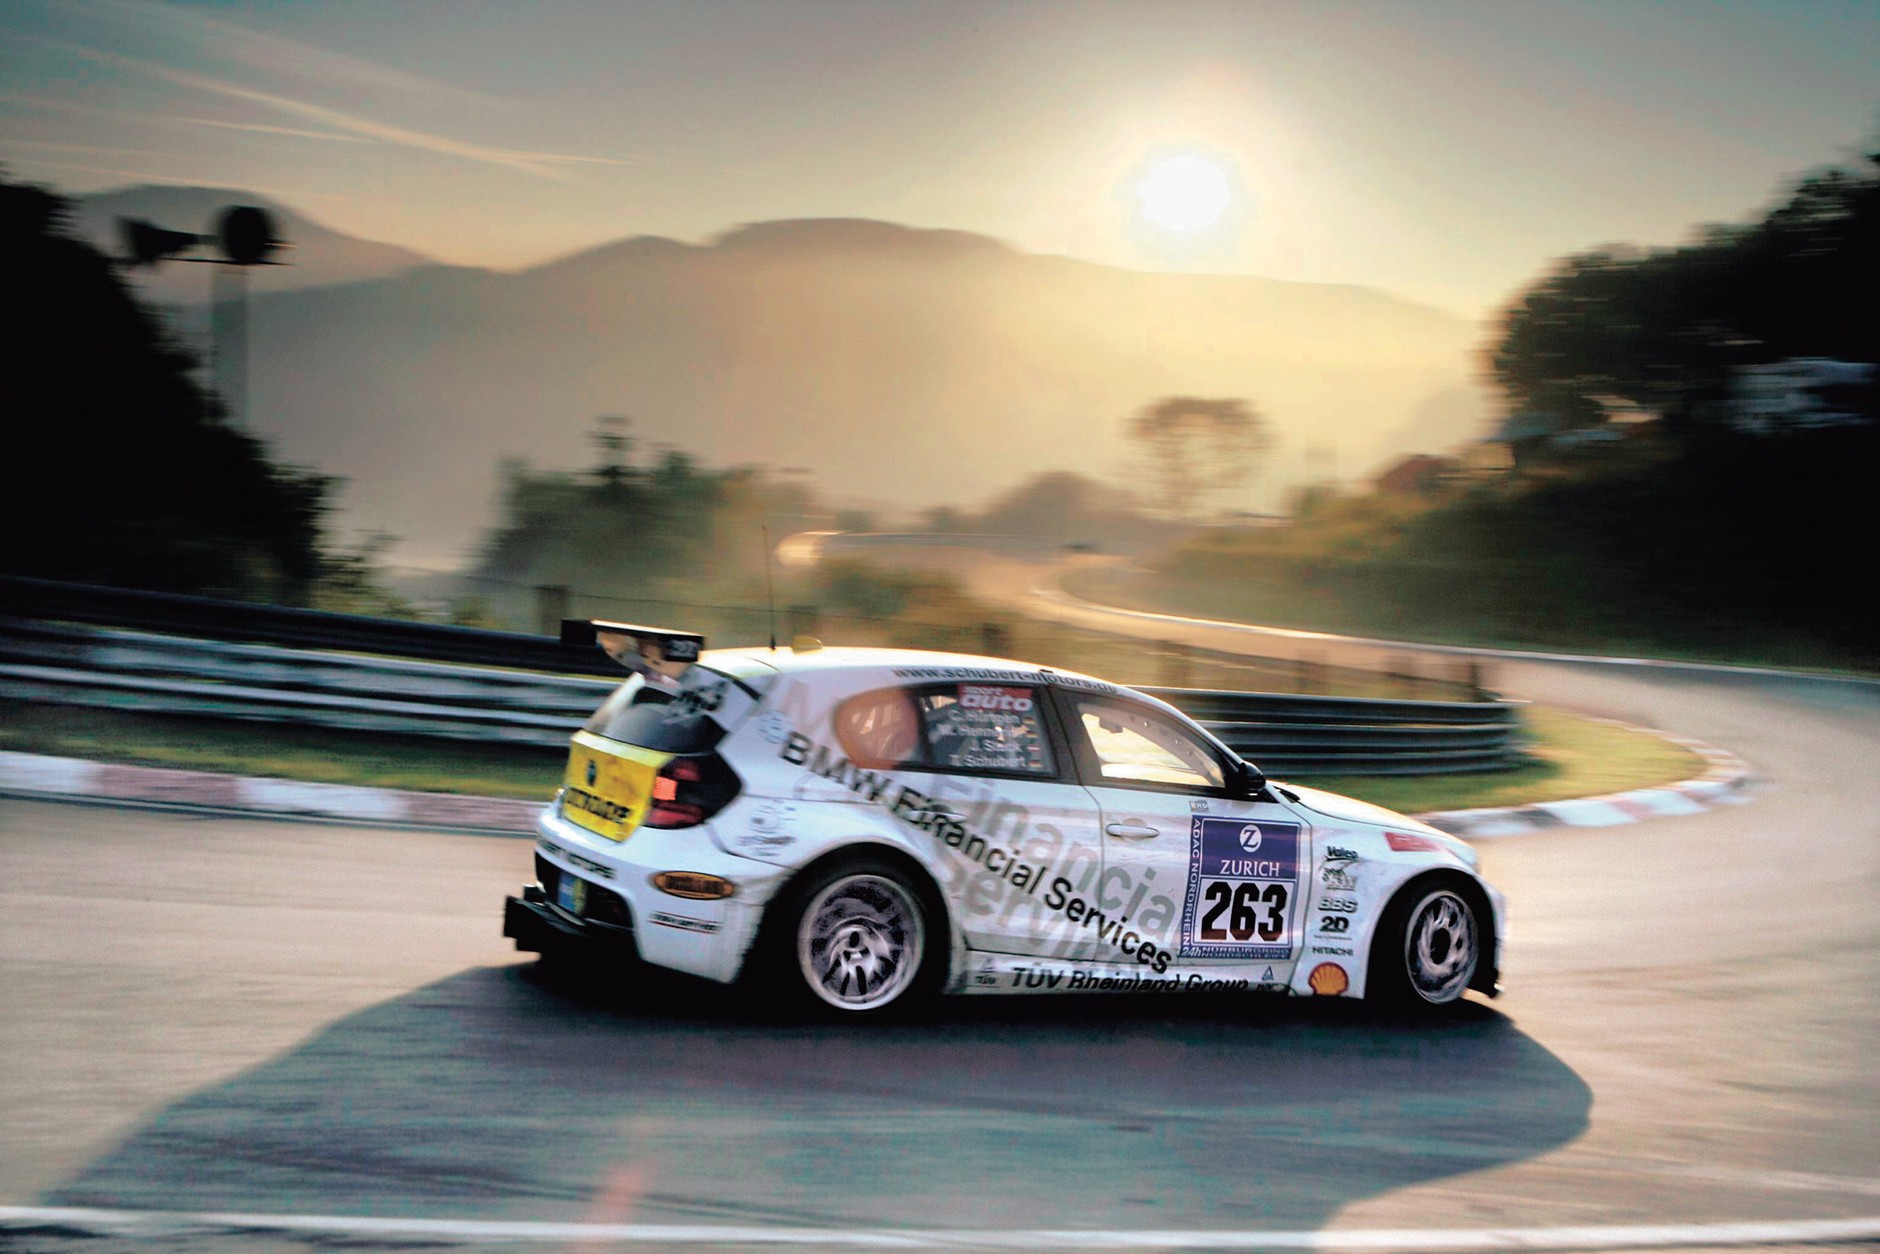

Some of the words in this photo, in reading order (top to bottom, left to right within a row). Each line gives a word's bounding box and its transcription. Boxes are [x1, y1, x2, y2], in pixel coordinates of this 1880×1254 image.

[960, 694, 1033, 712] auto
[1192, 818, 1201, 859] ADAC
[778, 731, 893, 801] BMW
[892, 785, 1048, 894] Financial
[1044, 876, 1172, 975] Services
[1220, 859, 1280, 877] ZURICH
[1182, 862, 1199, 946] NORDRHEIN
[1201, 881, 1288, 942] 263
[1318, 896, 1358, 913] BBS
[1319, 916, 1349, 933] 2D
[1181, 946, 1201, 957] 24h
[1312, 945, 1354, 957] HITACHI
[1067, 971, 1181, 992] Rheinland
